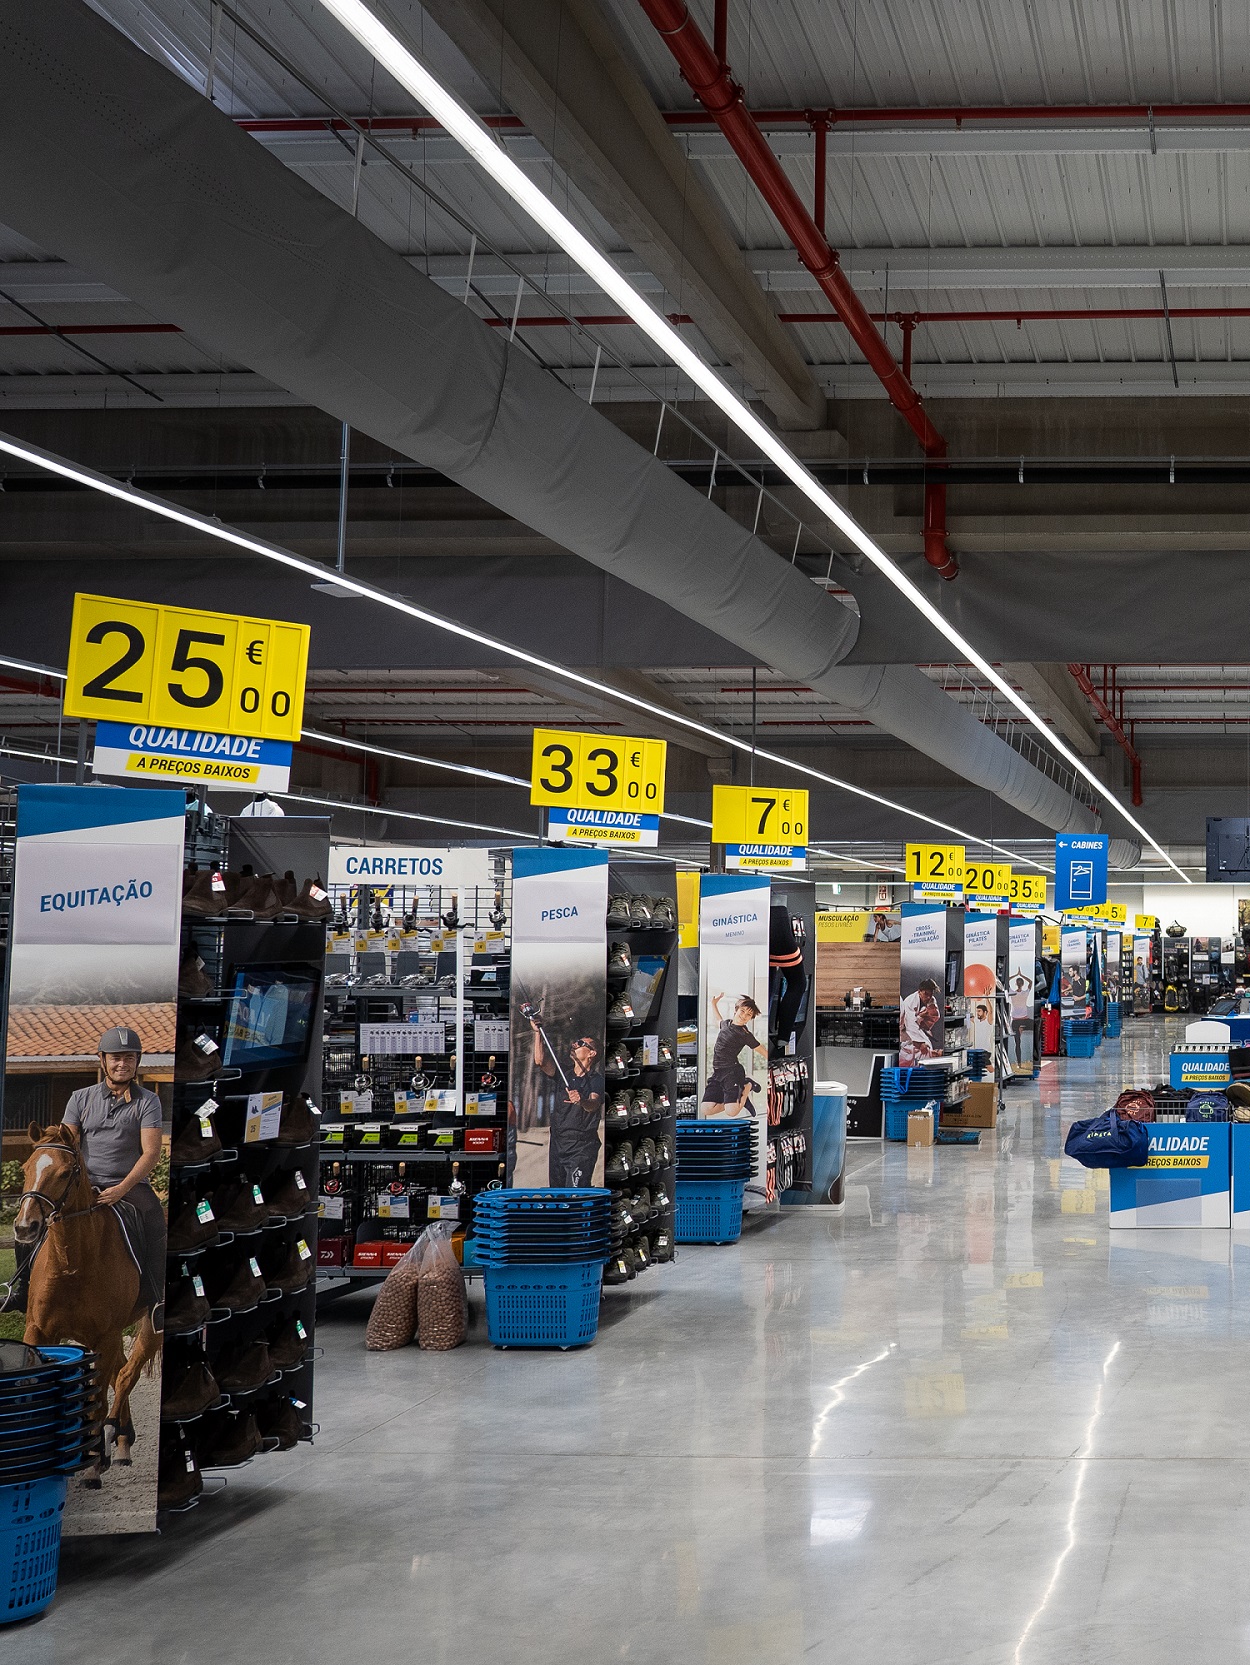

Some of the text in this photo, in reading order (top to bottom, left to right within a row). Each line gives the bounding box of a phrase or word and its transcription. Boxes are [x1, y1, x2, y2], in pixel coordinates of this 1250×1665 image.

[82, 620, 291, 718] 25 € 00
[129, 725, 264, 759] QUALIDADE
[136, 758, 252, 779] A PREÇOS BAIXOS
[540, 744, 658, 800] 33 € 00
[566, 809, 642, 827] QUALIDADE
[751, 797, 803, 836] 7 € 00
[572, 828, 636, 840] A PREÇOS BAIXOS
[738, 844, 794, 856] QUALIDADE
[1071, 840, 1104, 850] CABINES
[346, 856, 444, 876] CARRETOS
[749, 858, 768, 868] PREÇOS
[912, 851, 944, 877] 12
[922, 882, 956, 890] QUALIDADE
[966, 868, 994, 890] 20
[40, 879, 153, 912] EQUITAÇÃO
[1010, 880, 1032, 898] 35
[541, 905, 578, 922] PESCA
[818, 914, 860, 924] MUSCULAÇÃO
[1111, 907, 1118, 918] 5
[712, 913, 758, 928] GINÁSTICA
[1143, 916, 1148, 926] 7
[908, 934, 940, 944] MUSCULAÇÃO
[966, 930, 990, 938] GINÁSTICA
[1182, 1062, 1229, 1072] QUALIDADE
[1148, 1137, 1209, 1151] ALIDADE
[1145, 1158, 1201, 1168] REÇOS BAIXOS
